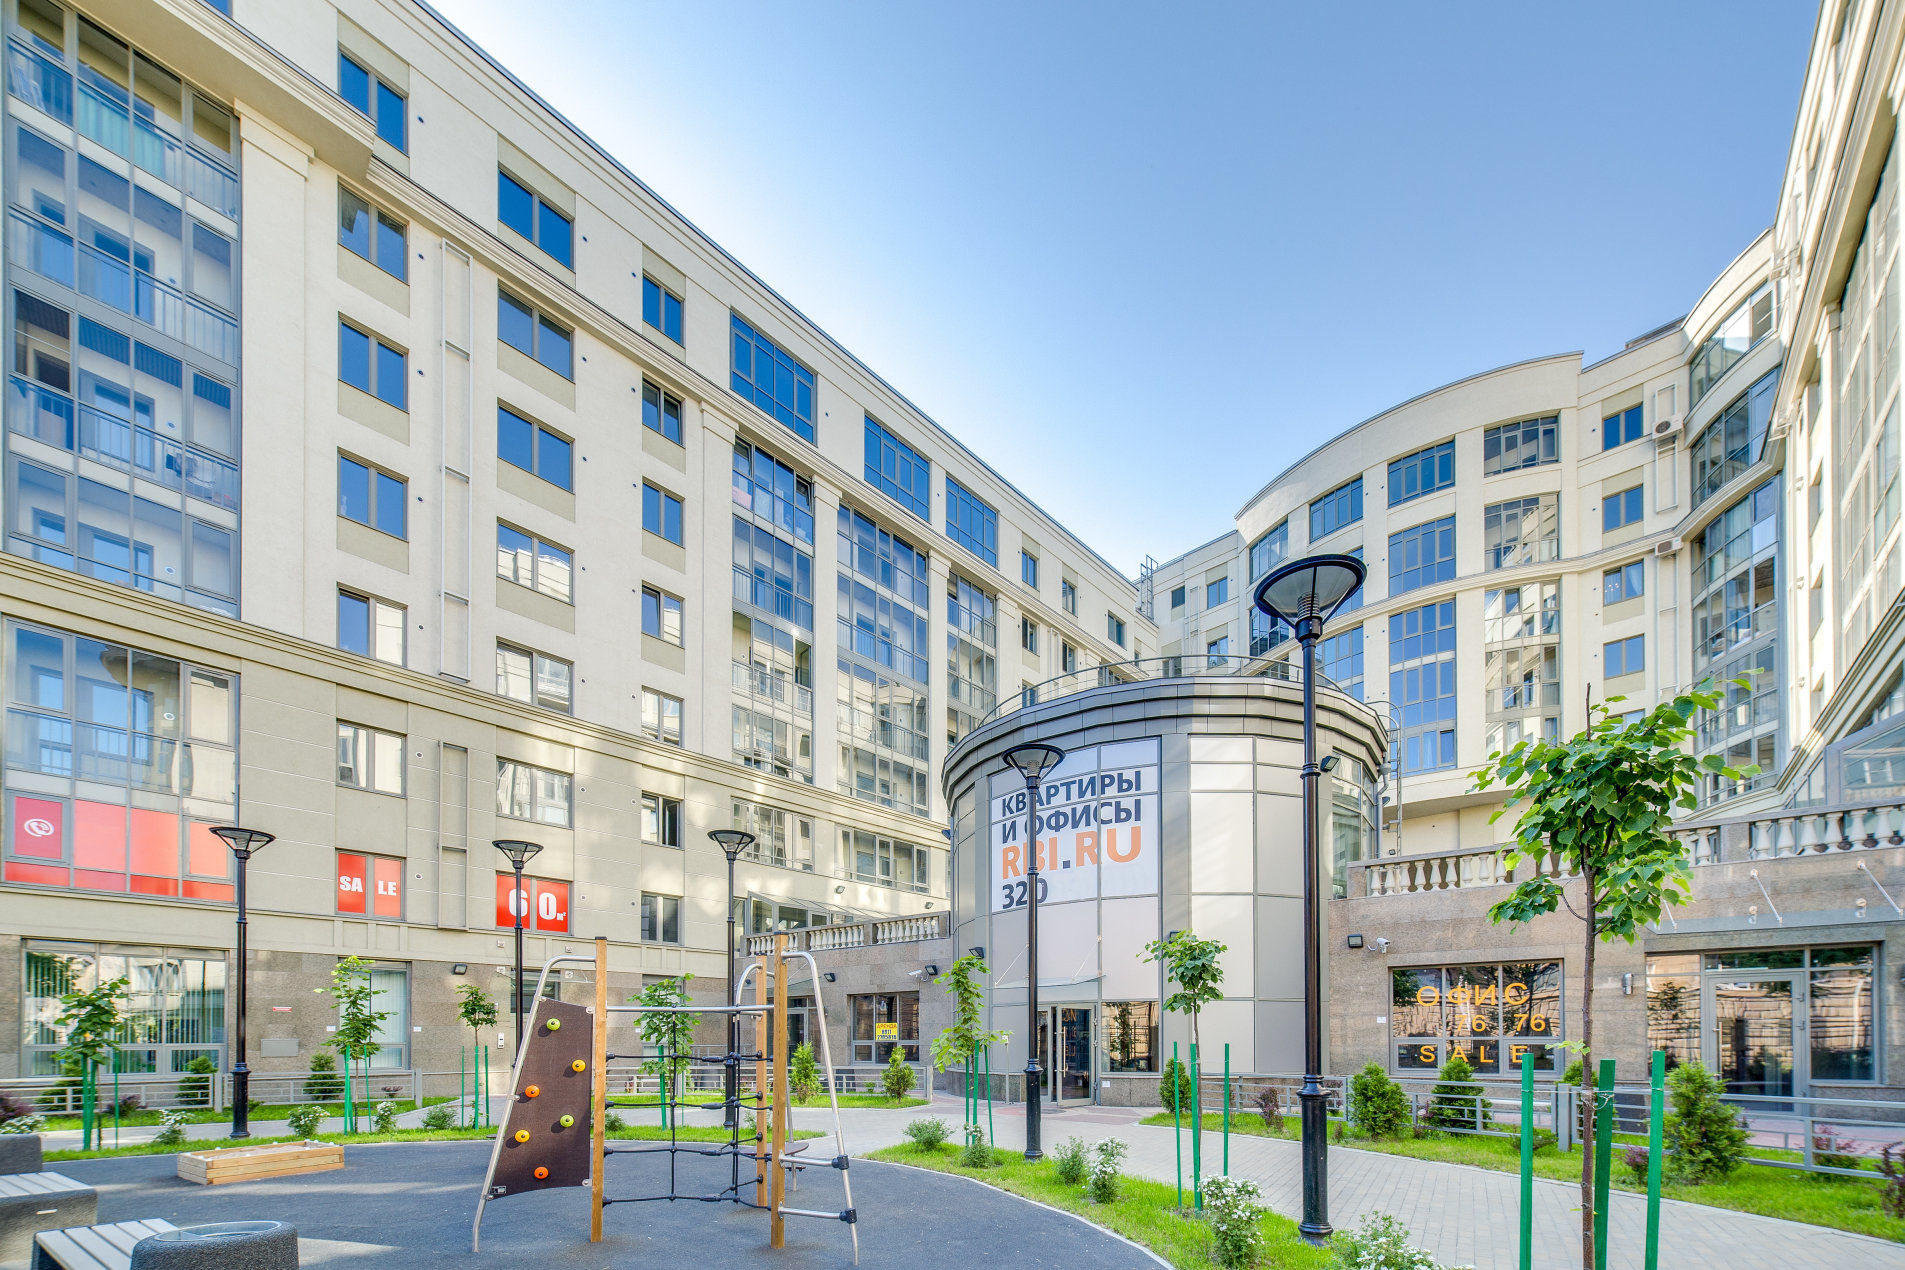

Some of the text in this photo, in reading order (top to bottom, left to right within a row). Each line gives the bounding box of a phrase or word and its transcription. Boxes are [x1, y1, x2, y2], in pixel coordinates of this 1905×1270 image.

[1002, 799, 1141, 844] И ОФИСЫ
[1002, 826, 1141, 880] RBI.RU
[1416, 982, 1530, 1007] ОФИС
[1455, 1013, 1546, 1032] 76 76
